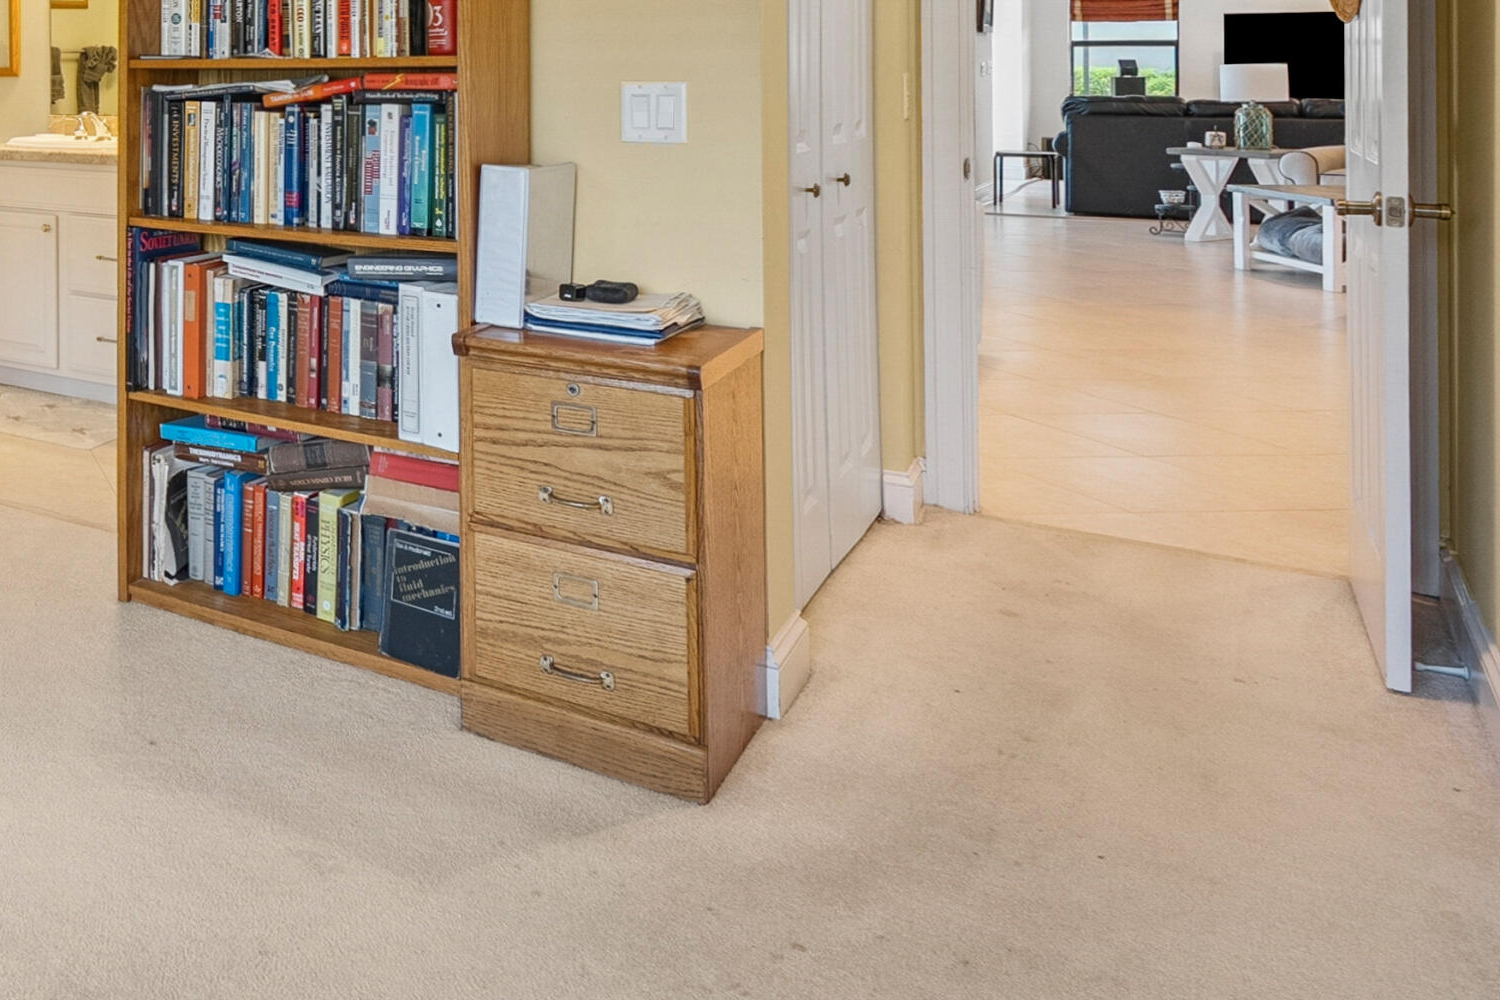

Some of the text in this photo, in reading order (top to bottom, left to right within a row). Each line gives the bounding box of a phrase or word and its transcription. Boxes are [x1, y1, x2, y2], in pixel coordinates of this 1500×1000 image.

[171, 120, 180, 184] INVESTMENTS
[321, 519, 331, 575] PHYSICS
[394, 555, 456, 575] introduction
[399, 579, 424, 592] fluid
